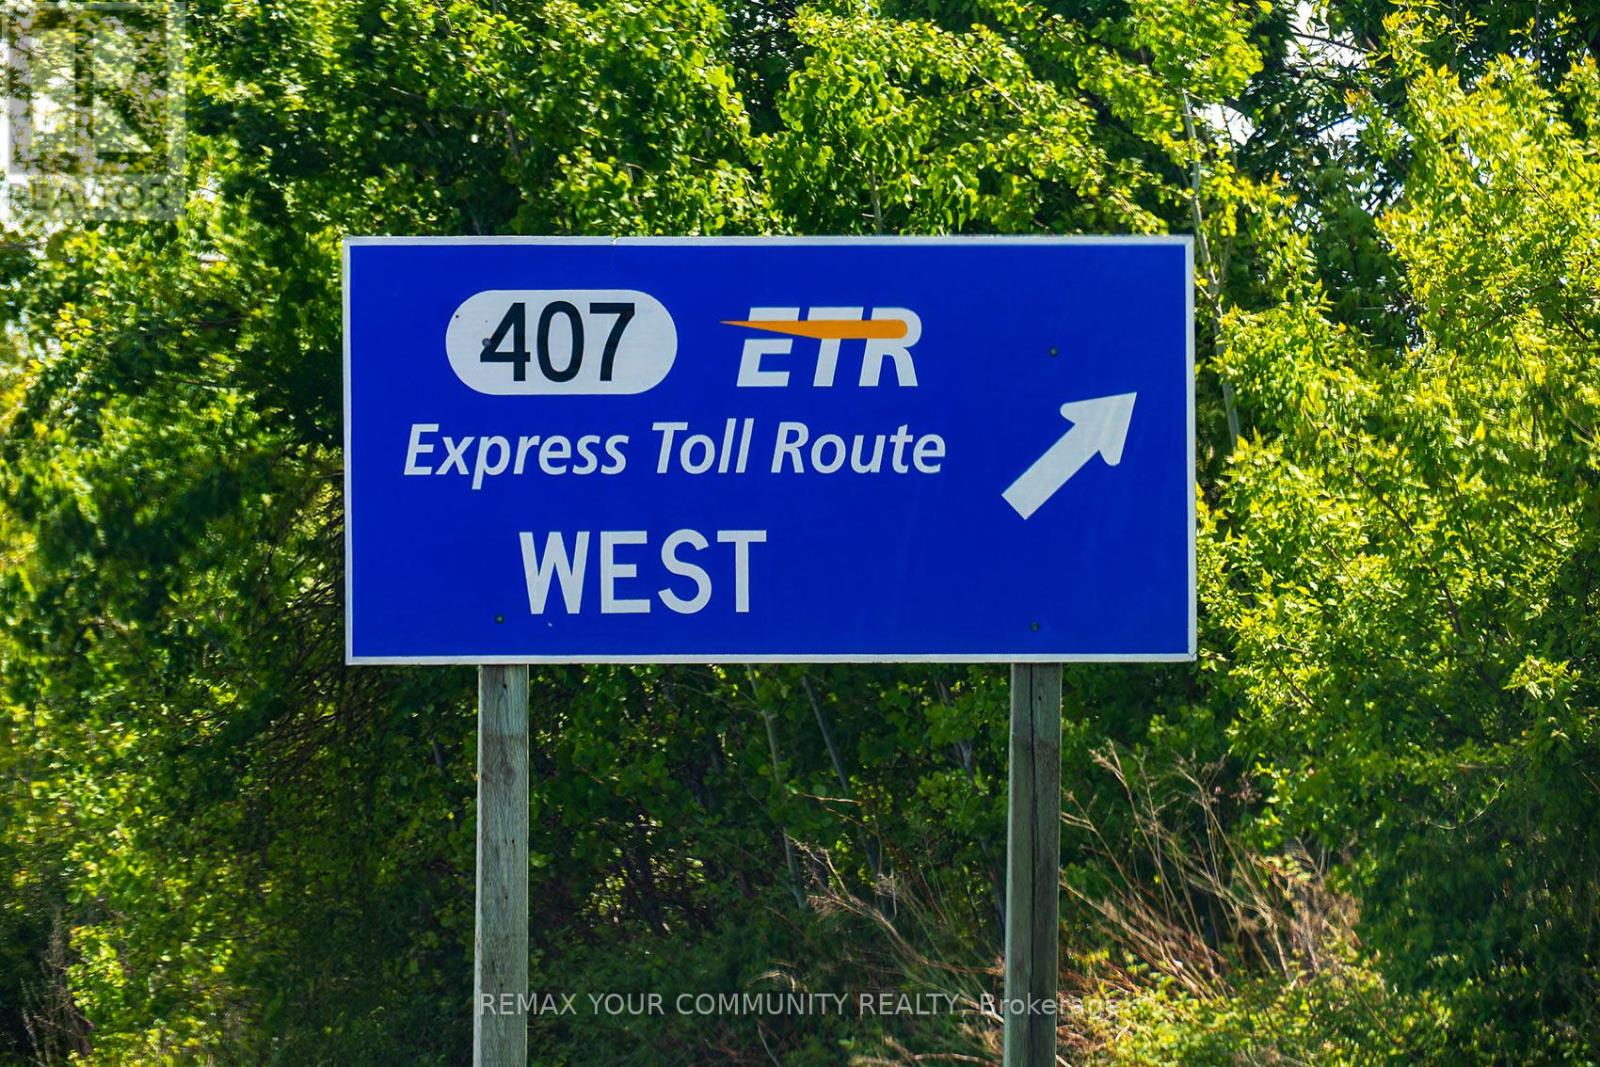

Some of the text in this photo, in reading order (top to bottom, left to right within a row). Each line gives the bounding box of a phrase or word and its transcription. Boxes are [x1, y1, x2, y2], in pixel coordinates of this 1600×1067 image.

[480, 301, 921, 388] 407 ETR
[404, 418, 946, 490] Express Toll Route
[519, 529, 766, 615] WEST
